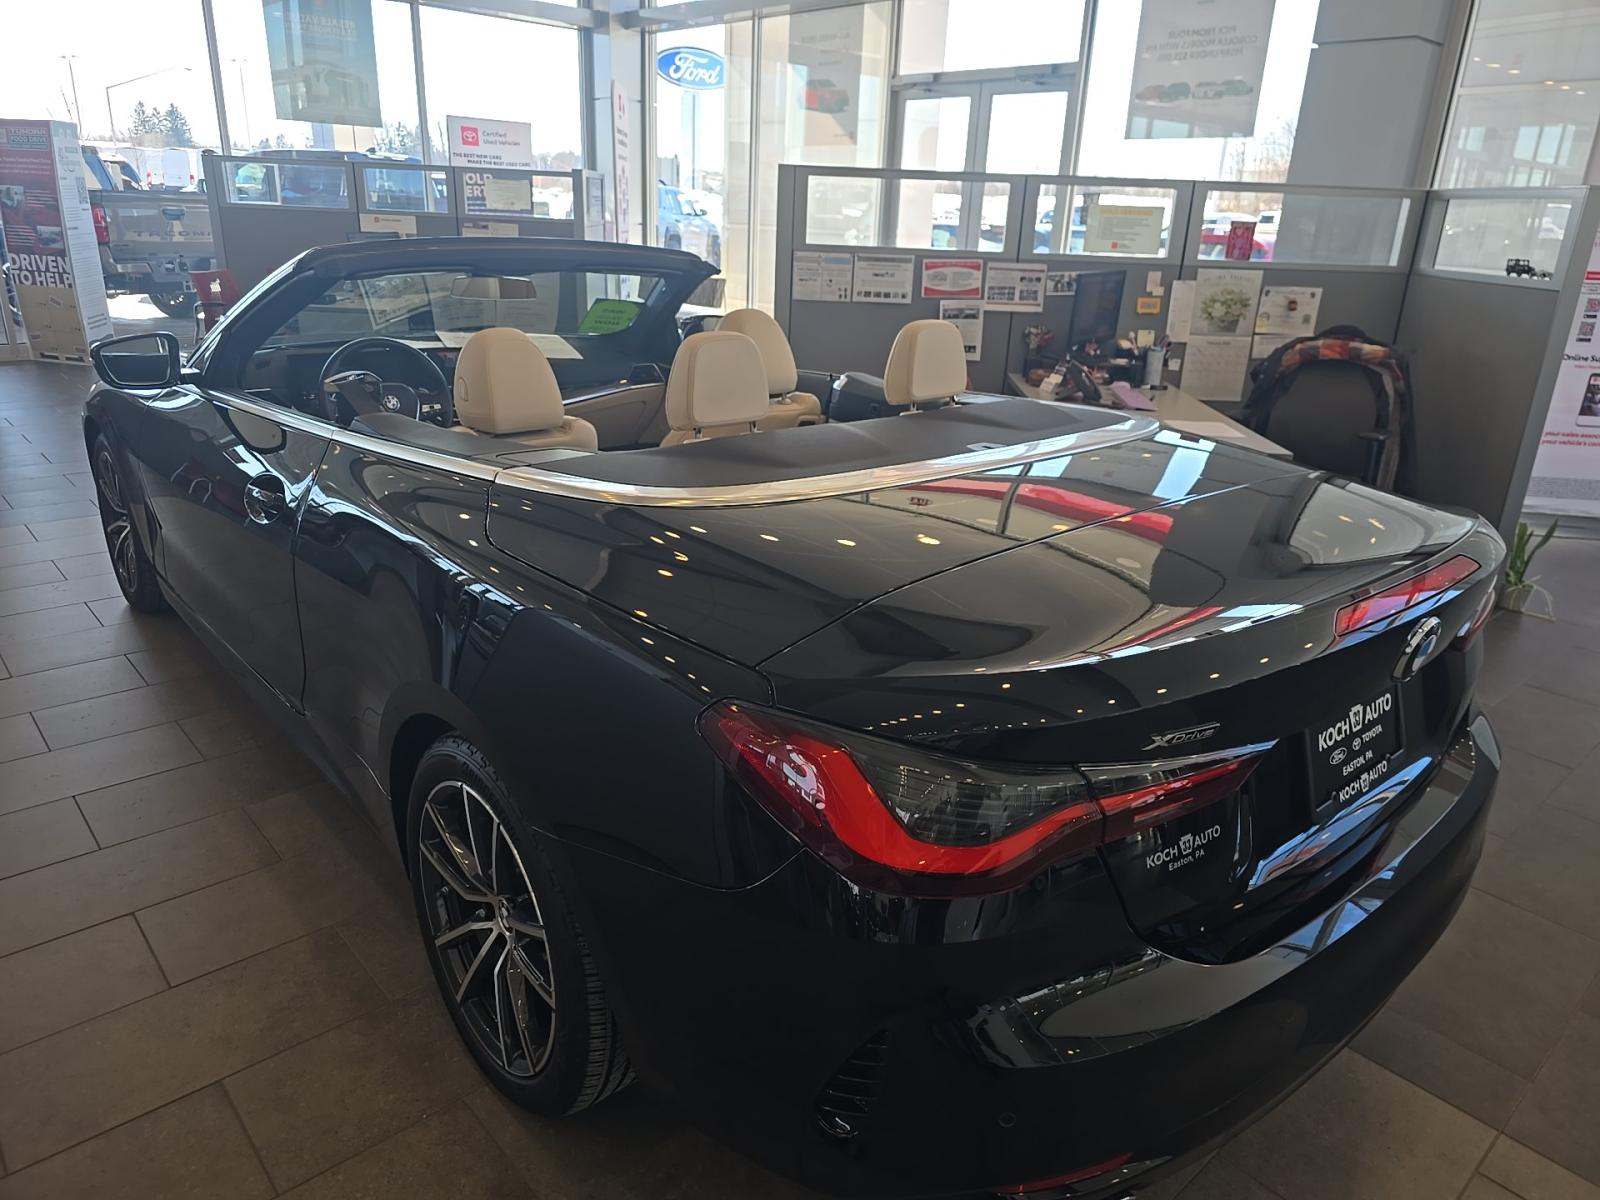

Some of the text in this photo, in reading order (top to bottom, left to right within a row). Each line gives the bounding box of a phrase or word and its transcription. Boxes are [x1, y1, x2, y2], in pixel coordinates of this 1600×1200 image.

[669, 52, 721, 85] Ford
[482, 130, 507, 138] Certified
[8, 253, 70, 273] DRIVEN
[12, 270, 73, 288] TO HELP
[1563, 352, 1589, 362] Online
[1318, 718, 1350, 752] KOCH
[1364, 693, 1391, 724] AUTO
[1362, 724, 1382, 742] TOYOTA
[1339, 779, 1360, 803] KOCH
[1369, 760, 1388, 783] AUTO
[1146, 845, 1178, 869] KOCH
[1194, 825, 1221, 848] AUTO
